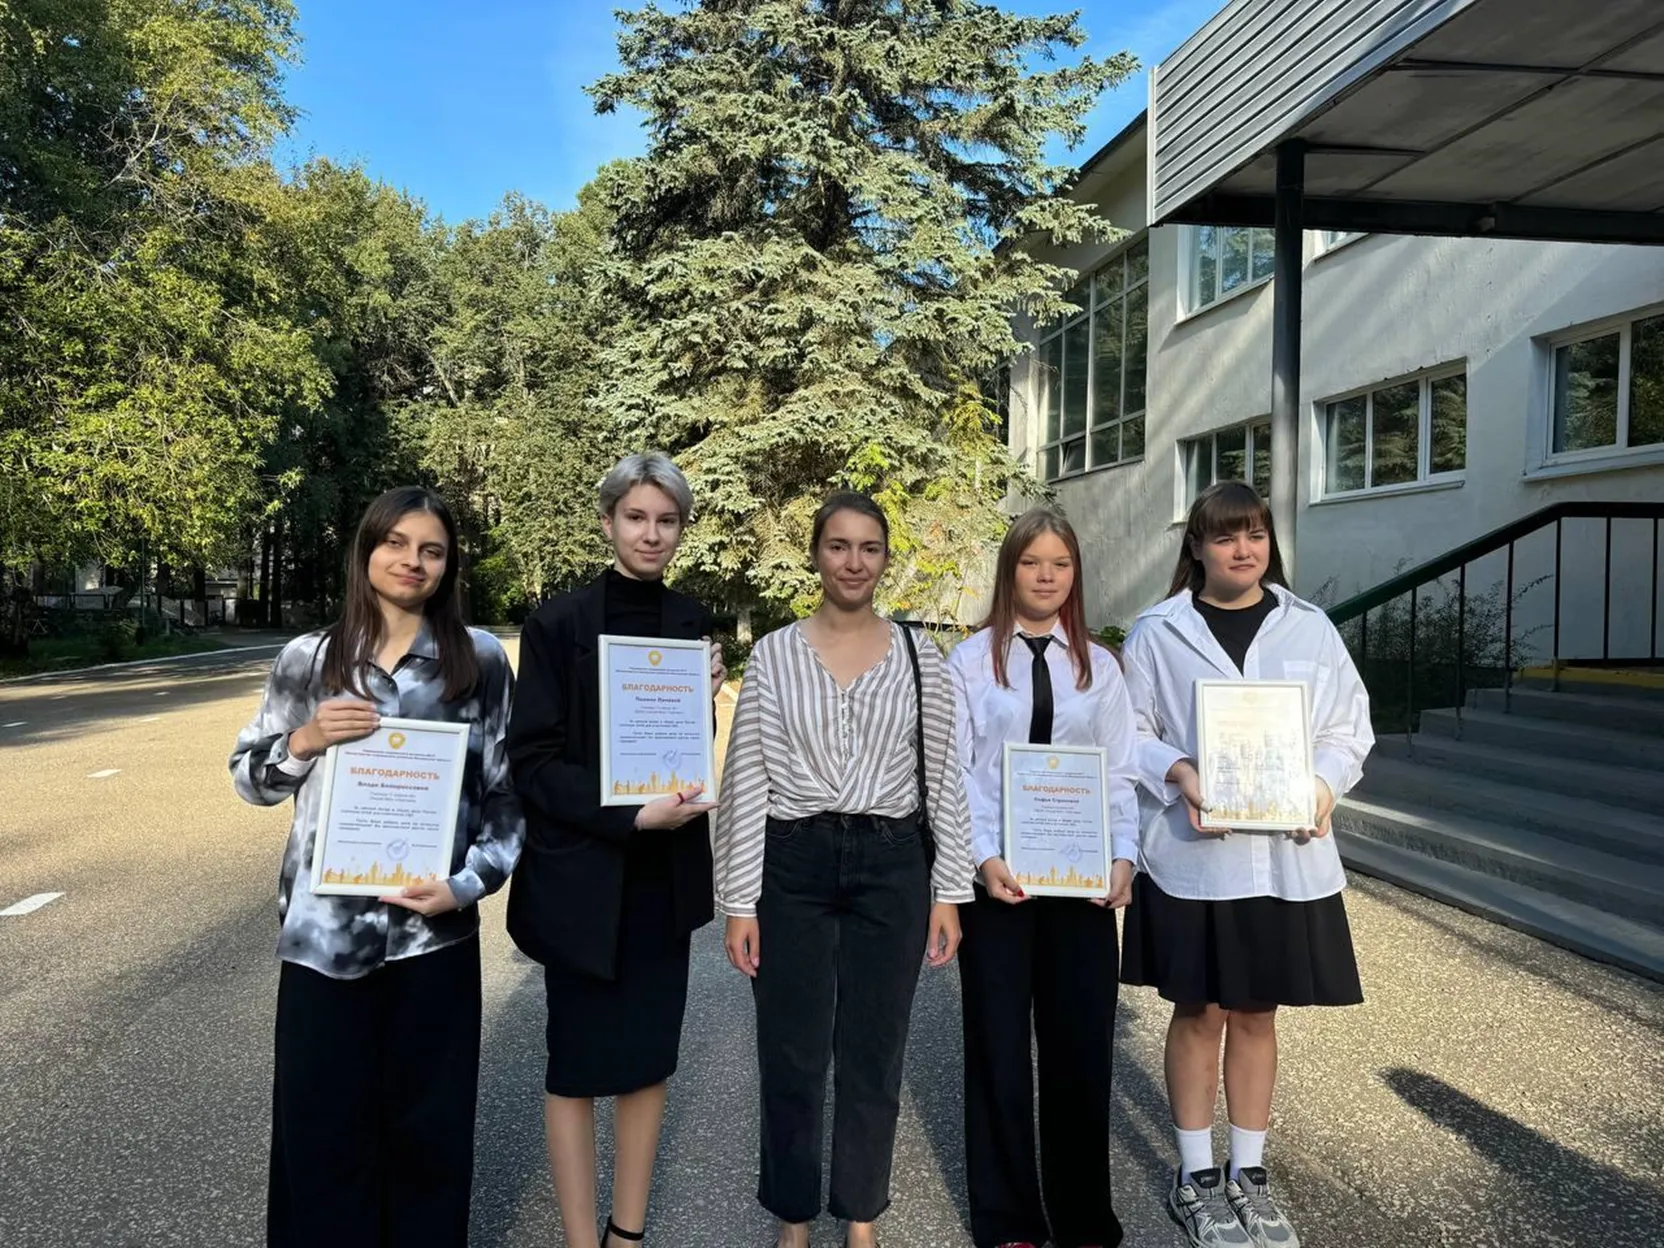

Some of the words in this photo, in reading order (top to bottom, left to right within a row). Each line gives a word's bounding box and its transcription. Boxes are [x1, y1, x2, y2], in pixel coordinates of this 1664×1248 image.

[622, 683, 694, 693] БЛАГОДАРНОСТЬ
[350, 766, 440, 780] БЛАГОДАРНОСТЬ
[1022, 784, 1091, 794] БЛАГОДАРНОСТЬ
